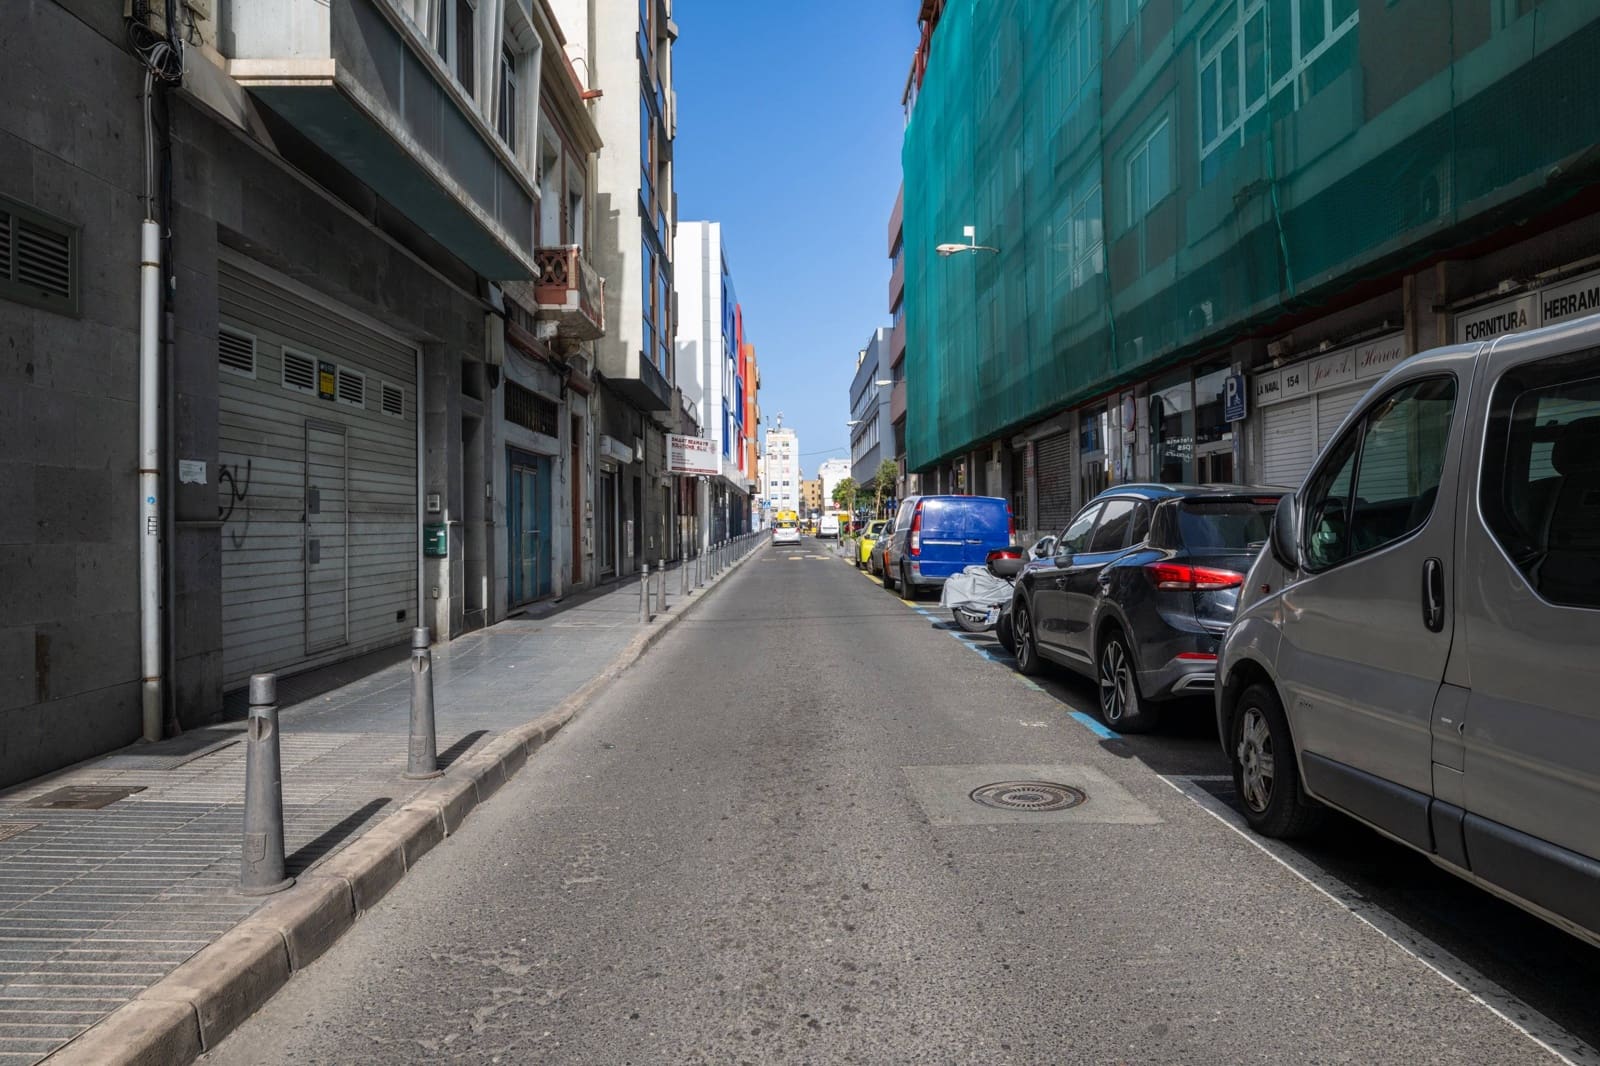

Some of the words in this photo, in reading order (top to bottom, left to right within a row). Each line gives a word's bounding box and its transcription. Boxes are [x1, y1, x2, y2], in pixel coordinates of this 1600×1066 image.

[1465, 308, 1528, 341] FORNITURA
[1227, 378, 1237, 407] P
[1287, 373, 1300, 388] 154
